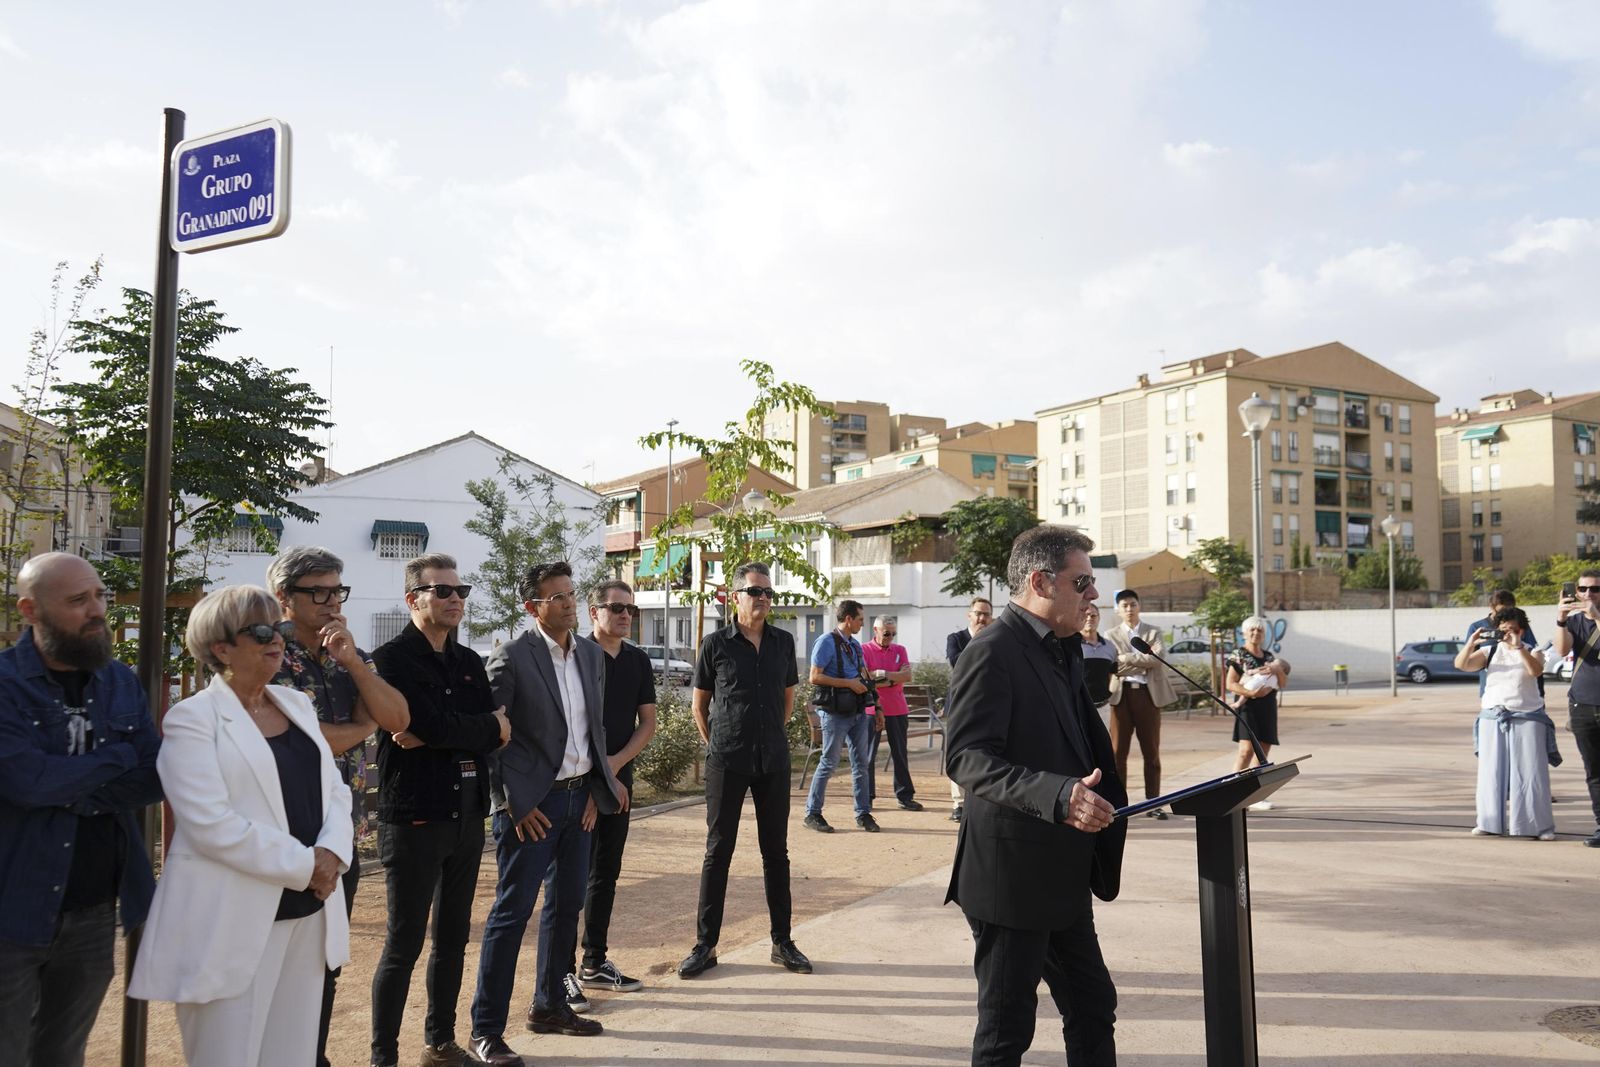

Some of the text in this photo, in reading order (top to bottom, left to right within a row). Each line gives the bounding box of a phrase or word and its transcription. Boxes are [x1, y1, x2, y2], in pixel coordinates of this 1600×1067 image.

[213, 153, 241, 168] PLAZA
[201, 172, 252, 199] GRUPO
[179, 193, 273, 235] GRANADINO 091
